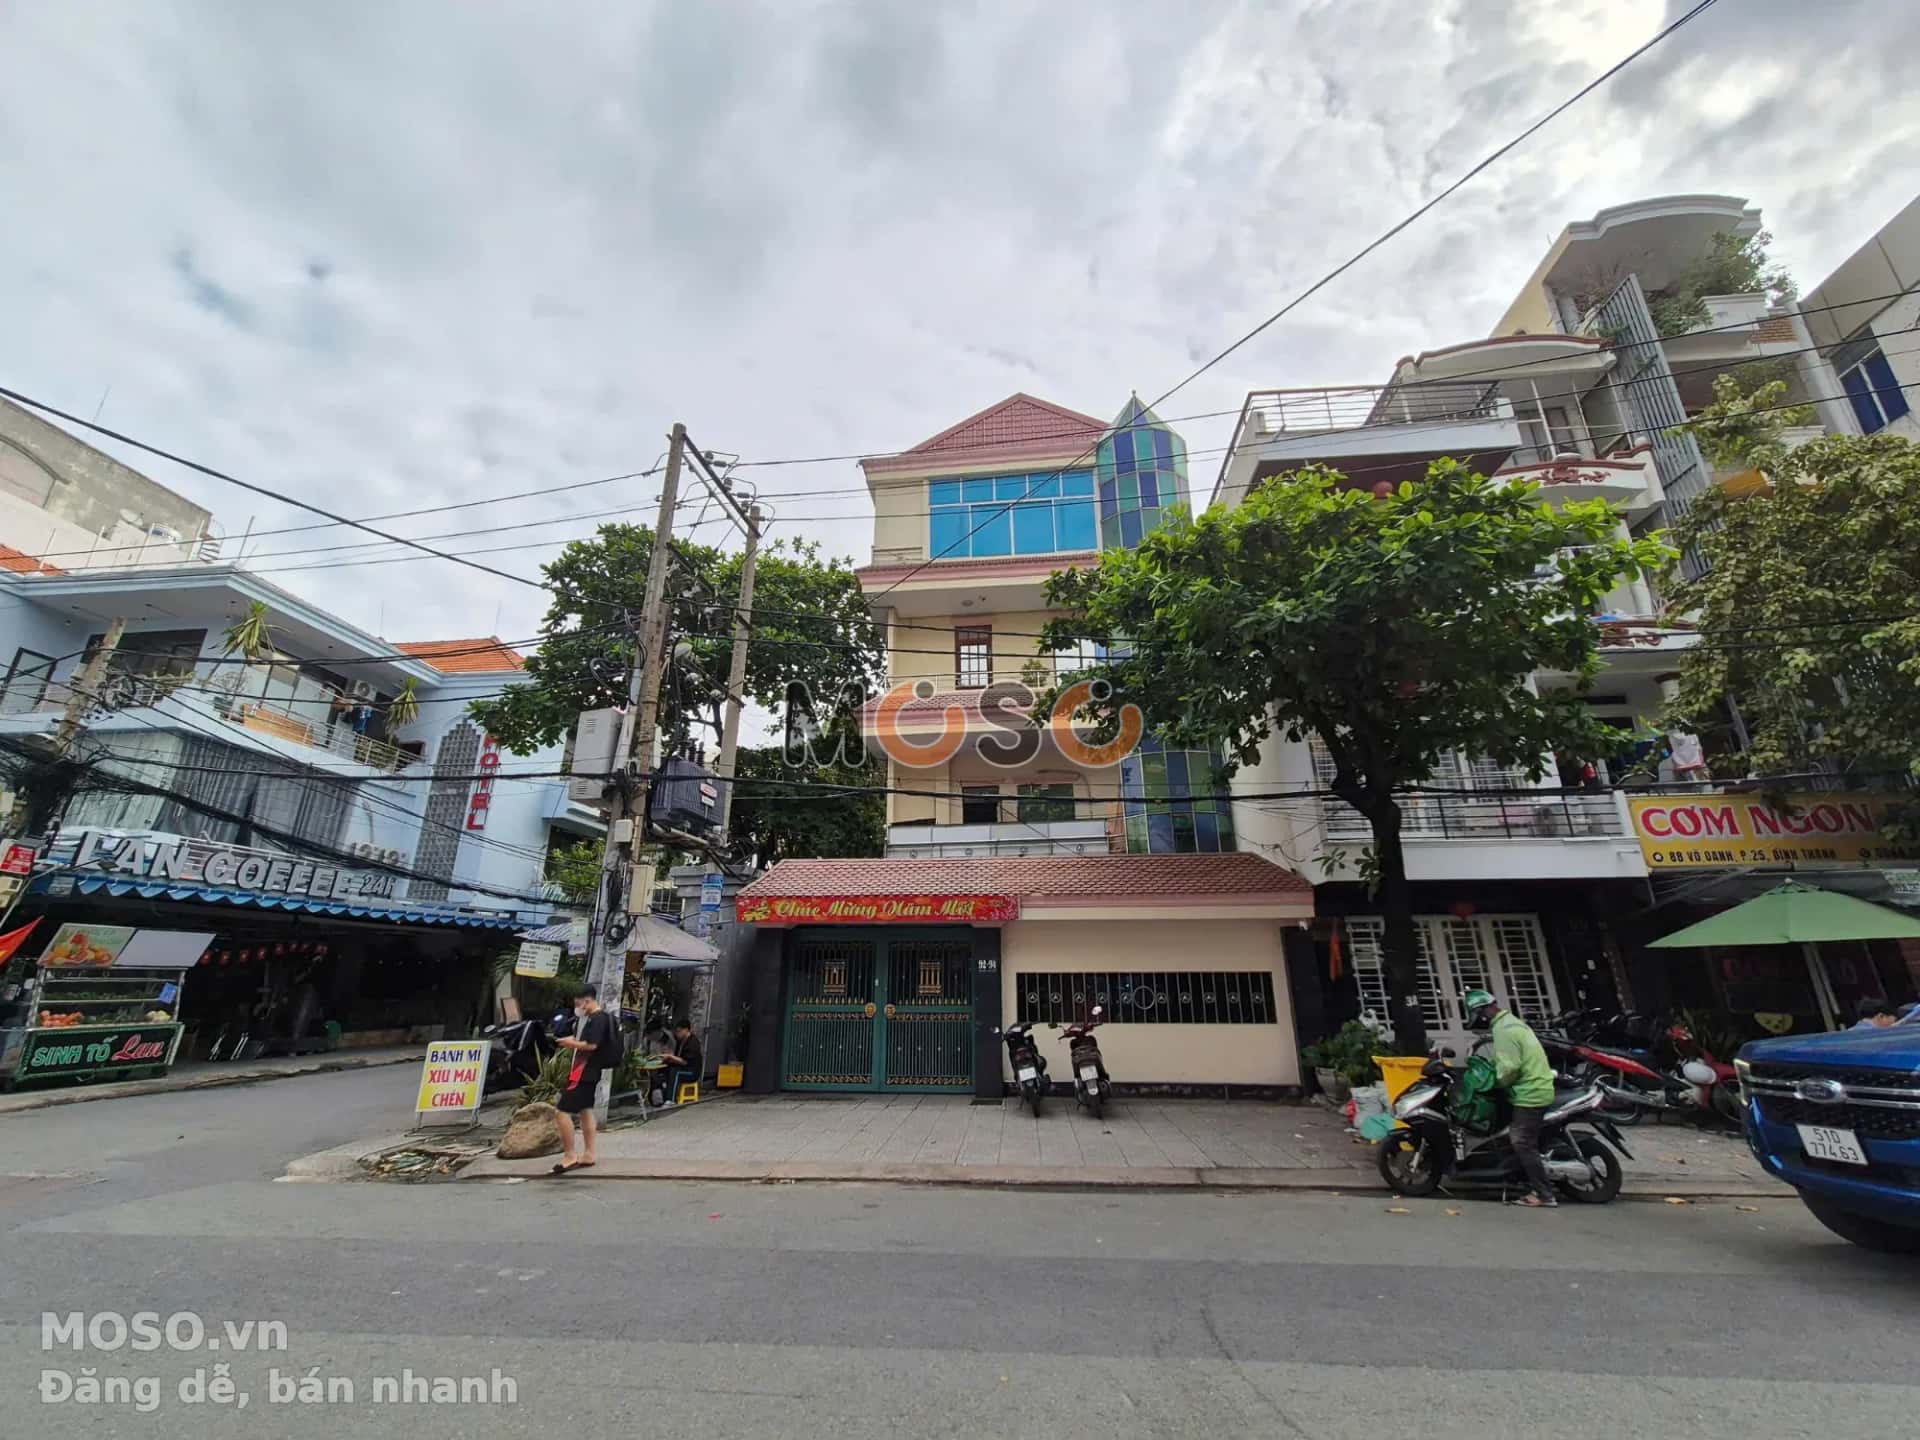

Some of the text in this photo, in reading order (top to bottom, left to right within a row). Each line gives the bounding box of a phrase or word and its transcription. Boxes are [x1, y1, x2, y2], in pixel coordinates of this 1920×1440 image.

[1641, 805, 1740, 836] CƠM
[204, 850, 359, 900] COFFEE
[31, 1044, 83, 1067] SINH
[1808, 1141, 1859, 1161] 77463
